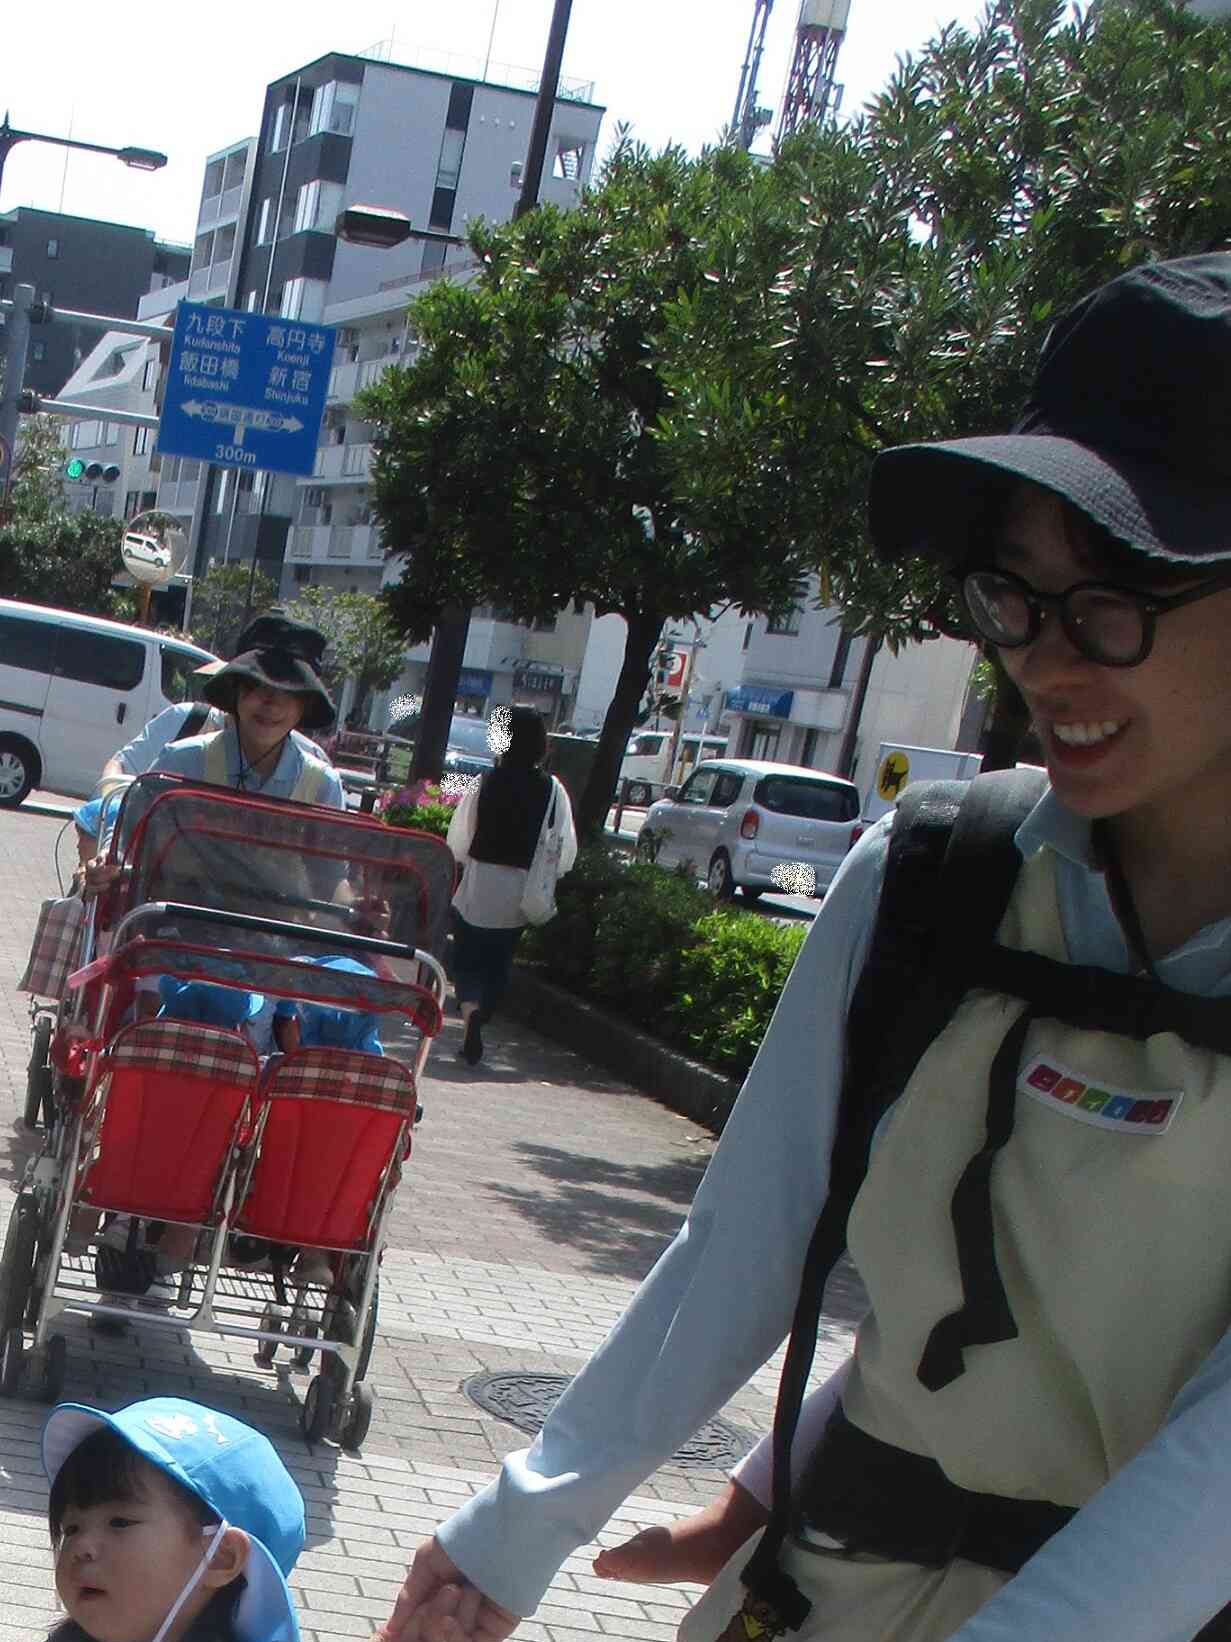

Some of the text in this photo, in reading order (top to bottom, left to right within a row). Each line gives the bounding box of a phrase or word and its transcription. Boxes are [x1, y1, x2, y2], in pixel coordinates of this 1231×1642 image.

[185, 312, 247, 339] 九段下
[184, 335, 241, 354] Kudanshita
[266, 325, 326, 355] 高円寺
[179, 351, 240, 380] 飯田橋
[269, 366, 312, 391] 新宿
[264, 388, 309, 405] Shinjuku
[215, 444, 256, 464] 300m
